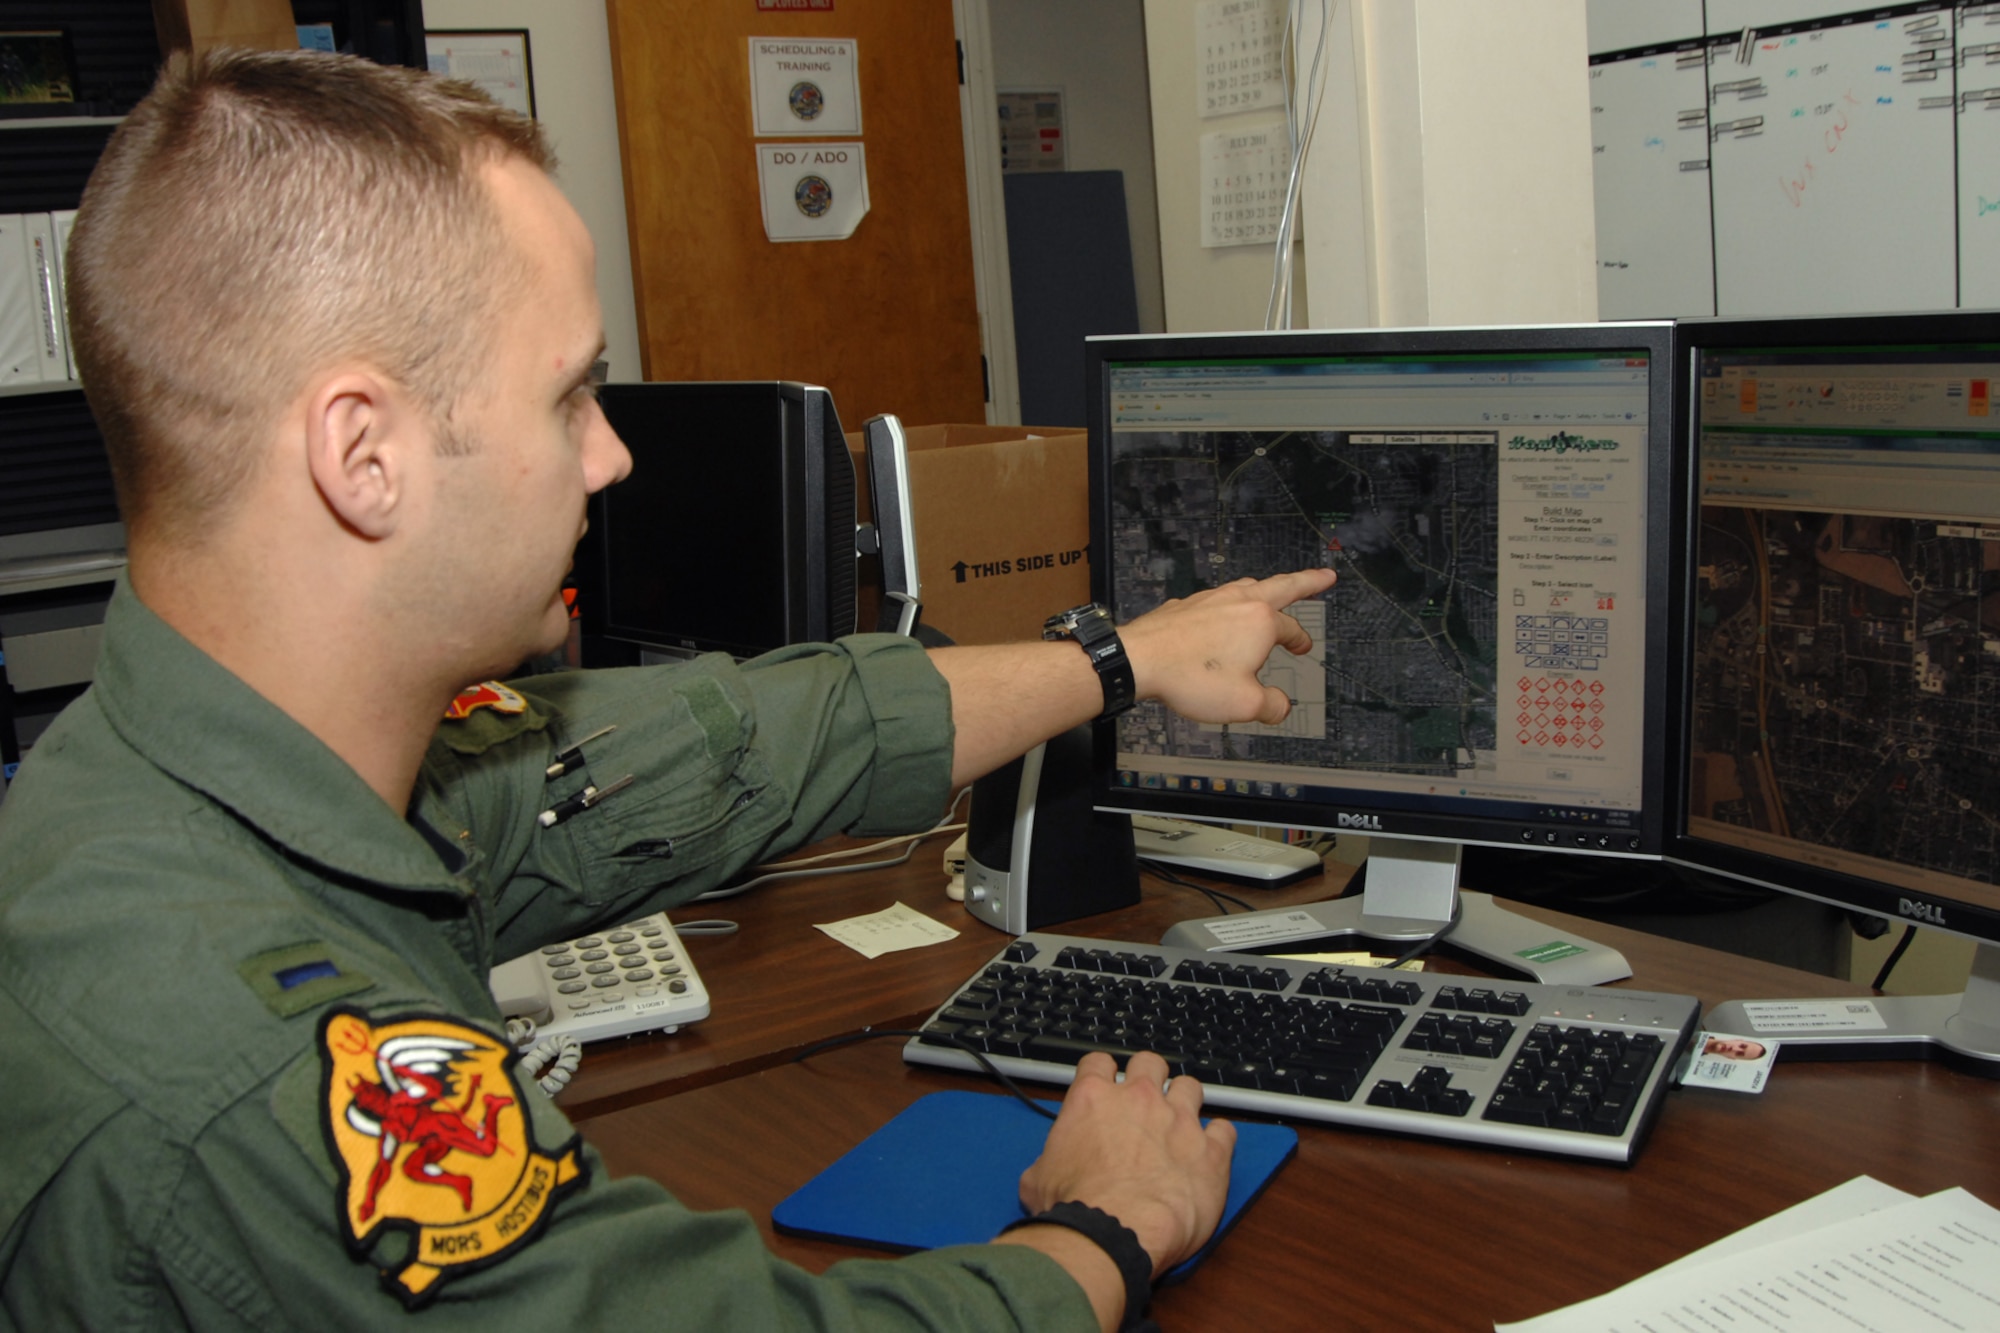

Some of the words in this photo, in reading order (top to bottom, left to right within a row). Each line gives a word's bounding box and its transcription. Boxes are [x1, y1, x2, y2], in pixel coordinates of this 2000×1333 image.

[760, 44, 835, 56] SCHEDULING
[838, 47, 846, 56] &
[776, 61, 832, 72] TRAINING
[774, 152, 796, 165] DO
[800, 152, 809, 164] /
[813, 151, 848, 164] ADO
[1543, 506, 1562, 515] Build
[1565, 507, 1583, 516] Map
[971, 560, 1012, 578] THIS
[1016, 554, 1054, 572] SIDE
[1059, 550, 1082, 566] UP
[1337, 812, 1383, 830] DELL
[1898, 897, 1946, 924] DELL
[636, 1001, 666, 1011] 110087
[573, 1007, 613, 1019] Advanced
[430, 1231, 482, 1254] MORS
[495, 1166, 549, 1239] HOSTIBUS
